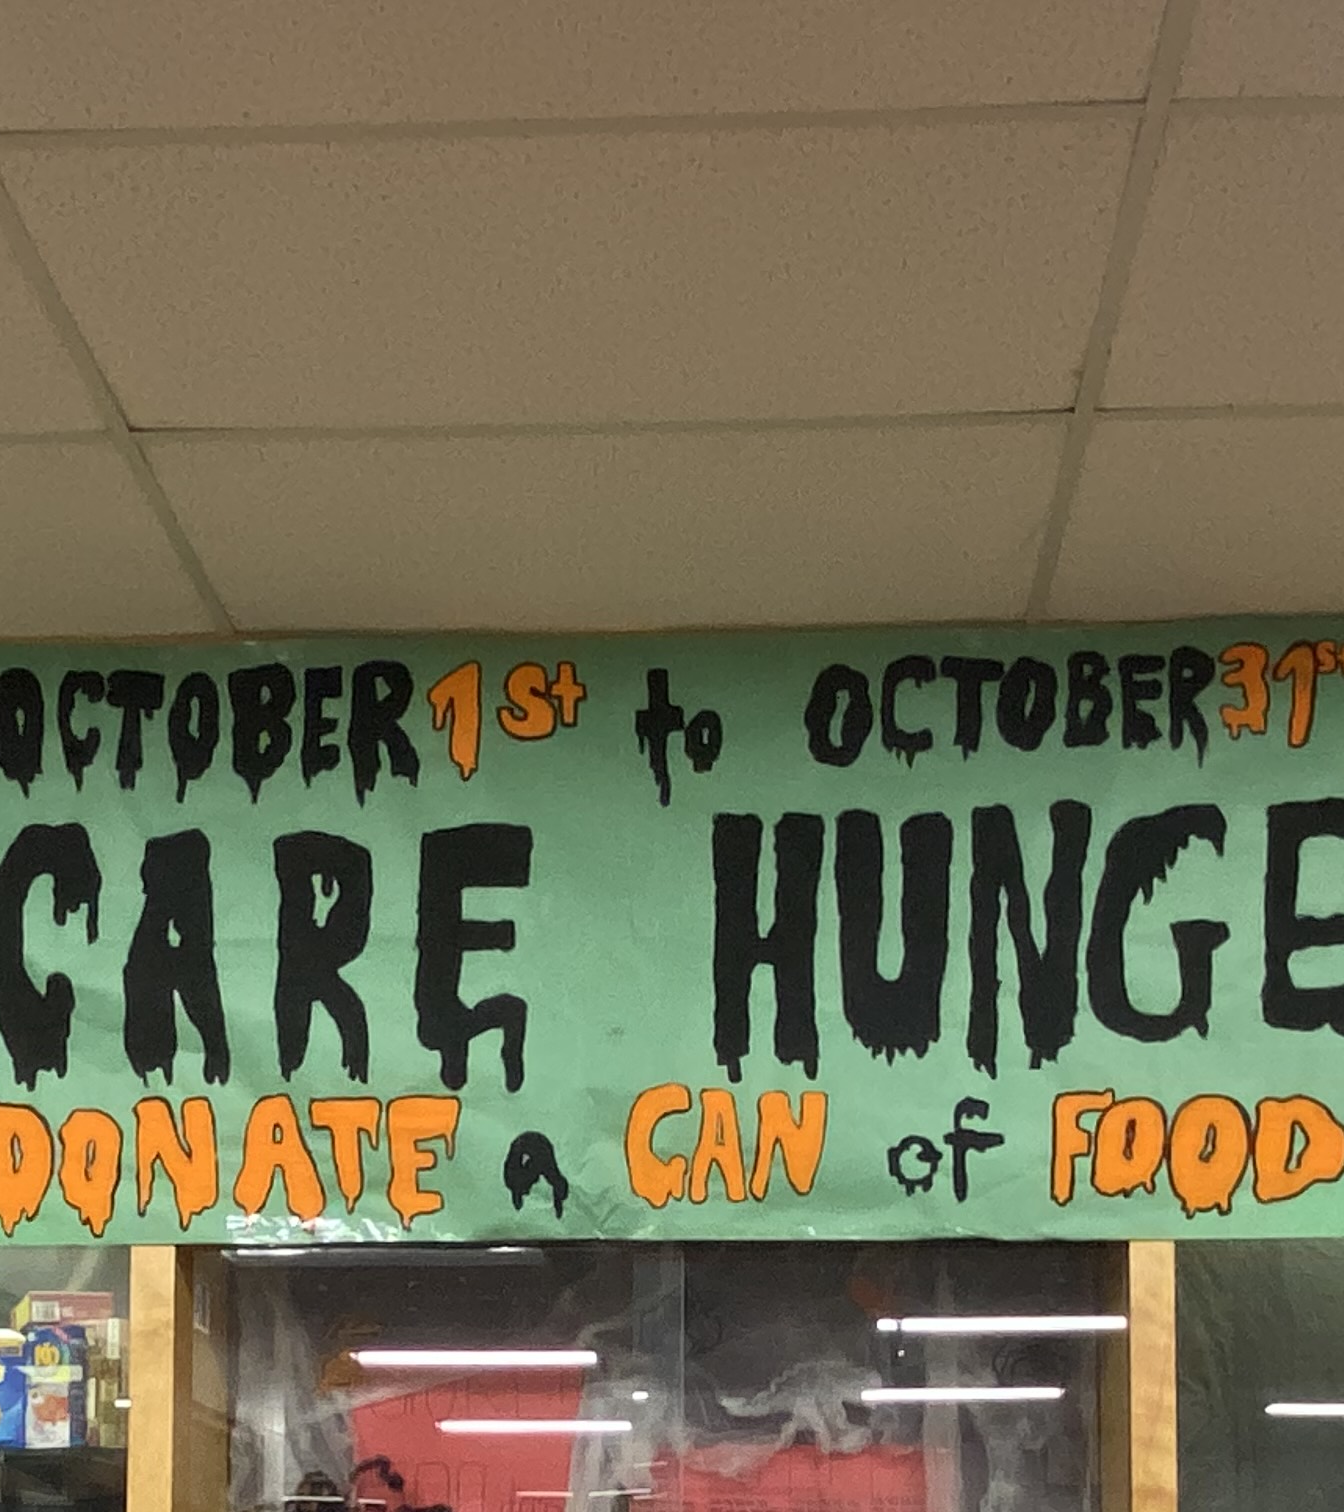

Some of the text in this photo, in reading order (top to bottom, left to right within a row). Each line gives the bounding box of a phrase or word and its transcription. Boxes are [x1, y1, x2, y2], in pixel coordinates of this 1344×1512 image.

[636, 667, 723, 806] to
[804, 650, 1209, 767] OCTOBER
[503, 1131, 570, 1219] a
[625, 1082, 829, 1208] CAN
[887, 1097, 1005, 1202] of
